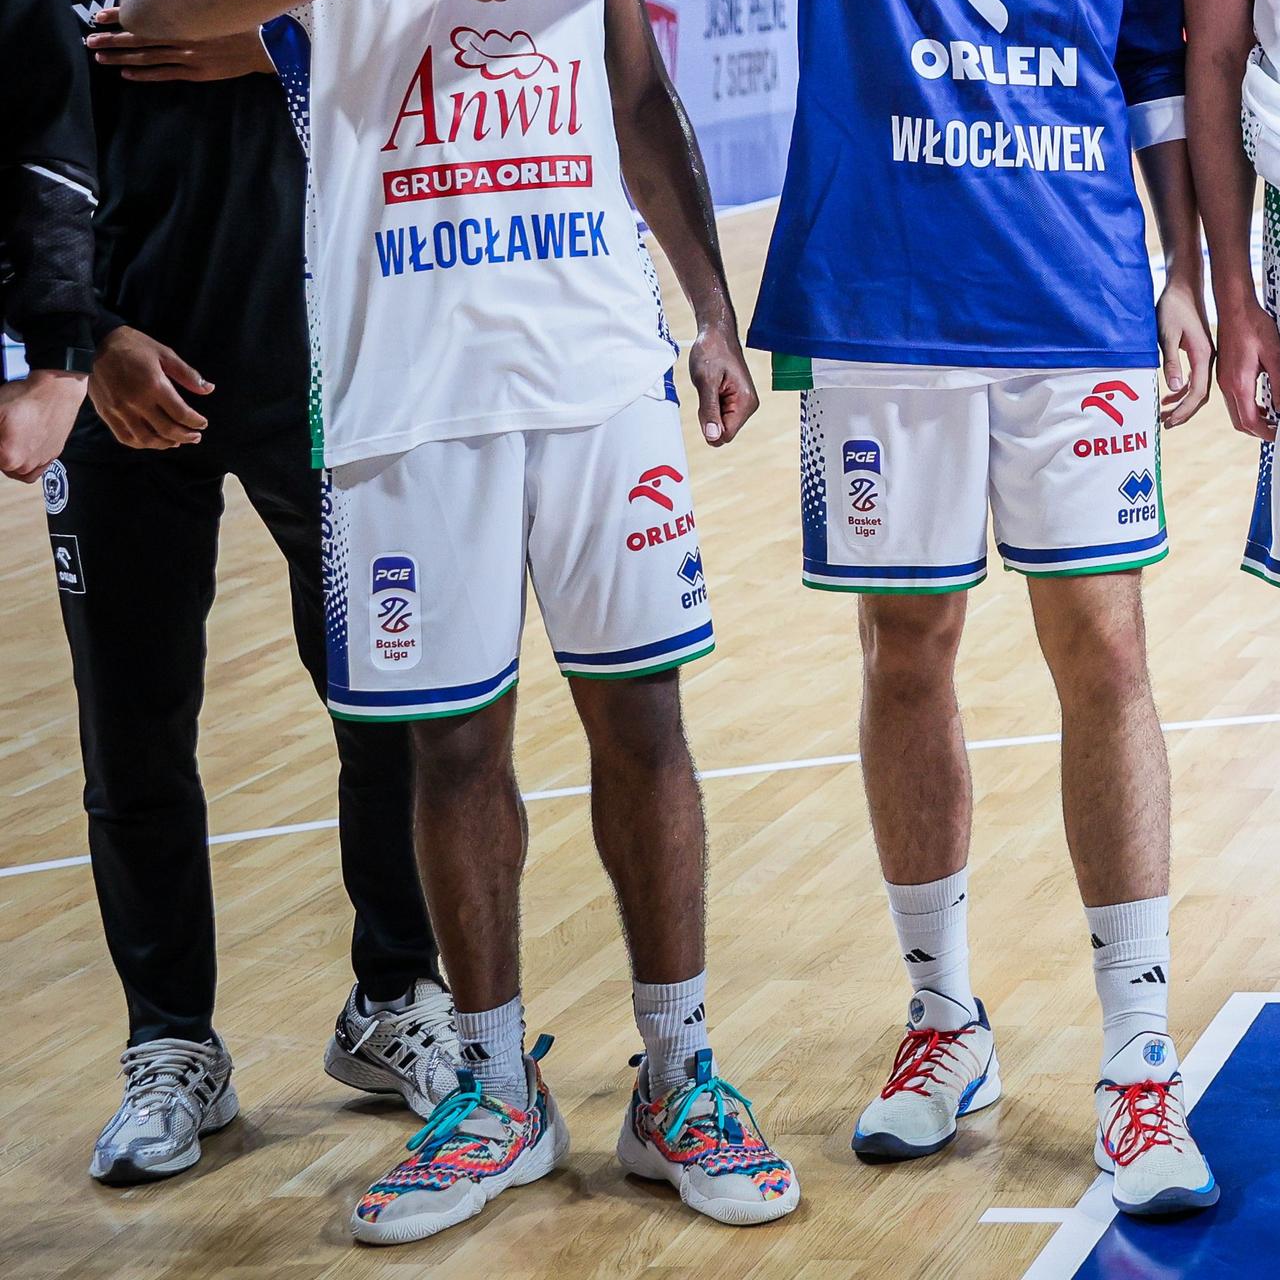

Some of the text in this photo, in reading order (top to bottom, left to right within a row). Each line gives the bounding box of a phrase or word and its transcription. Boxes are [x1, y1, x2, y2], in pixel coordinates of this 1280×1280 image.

[910, 38, 1078, 87] ORLEN
[380, 45, 584, 152] Anwil
[891, 115, 1105, 172] WŁOCŁAWEK
[375, 210, 610, 277] WŁOCŁAWEK
[1073, 431, 1148, 459] ORLEN
[845, 451, 877, 464] PGE
[847, 516, 882, 527] Basket
[1117, 503, 1157, 525] errea
[626, 510, 696, 552] ORLEN
[855, 527, 877, 538] Liga
[375, 568, 412, 581] PGE
[680, 584, 708, 609] erre
[375, 639, 416, 650] Basket
[384, 649, 409, 661] Liga
